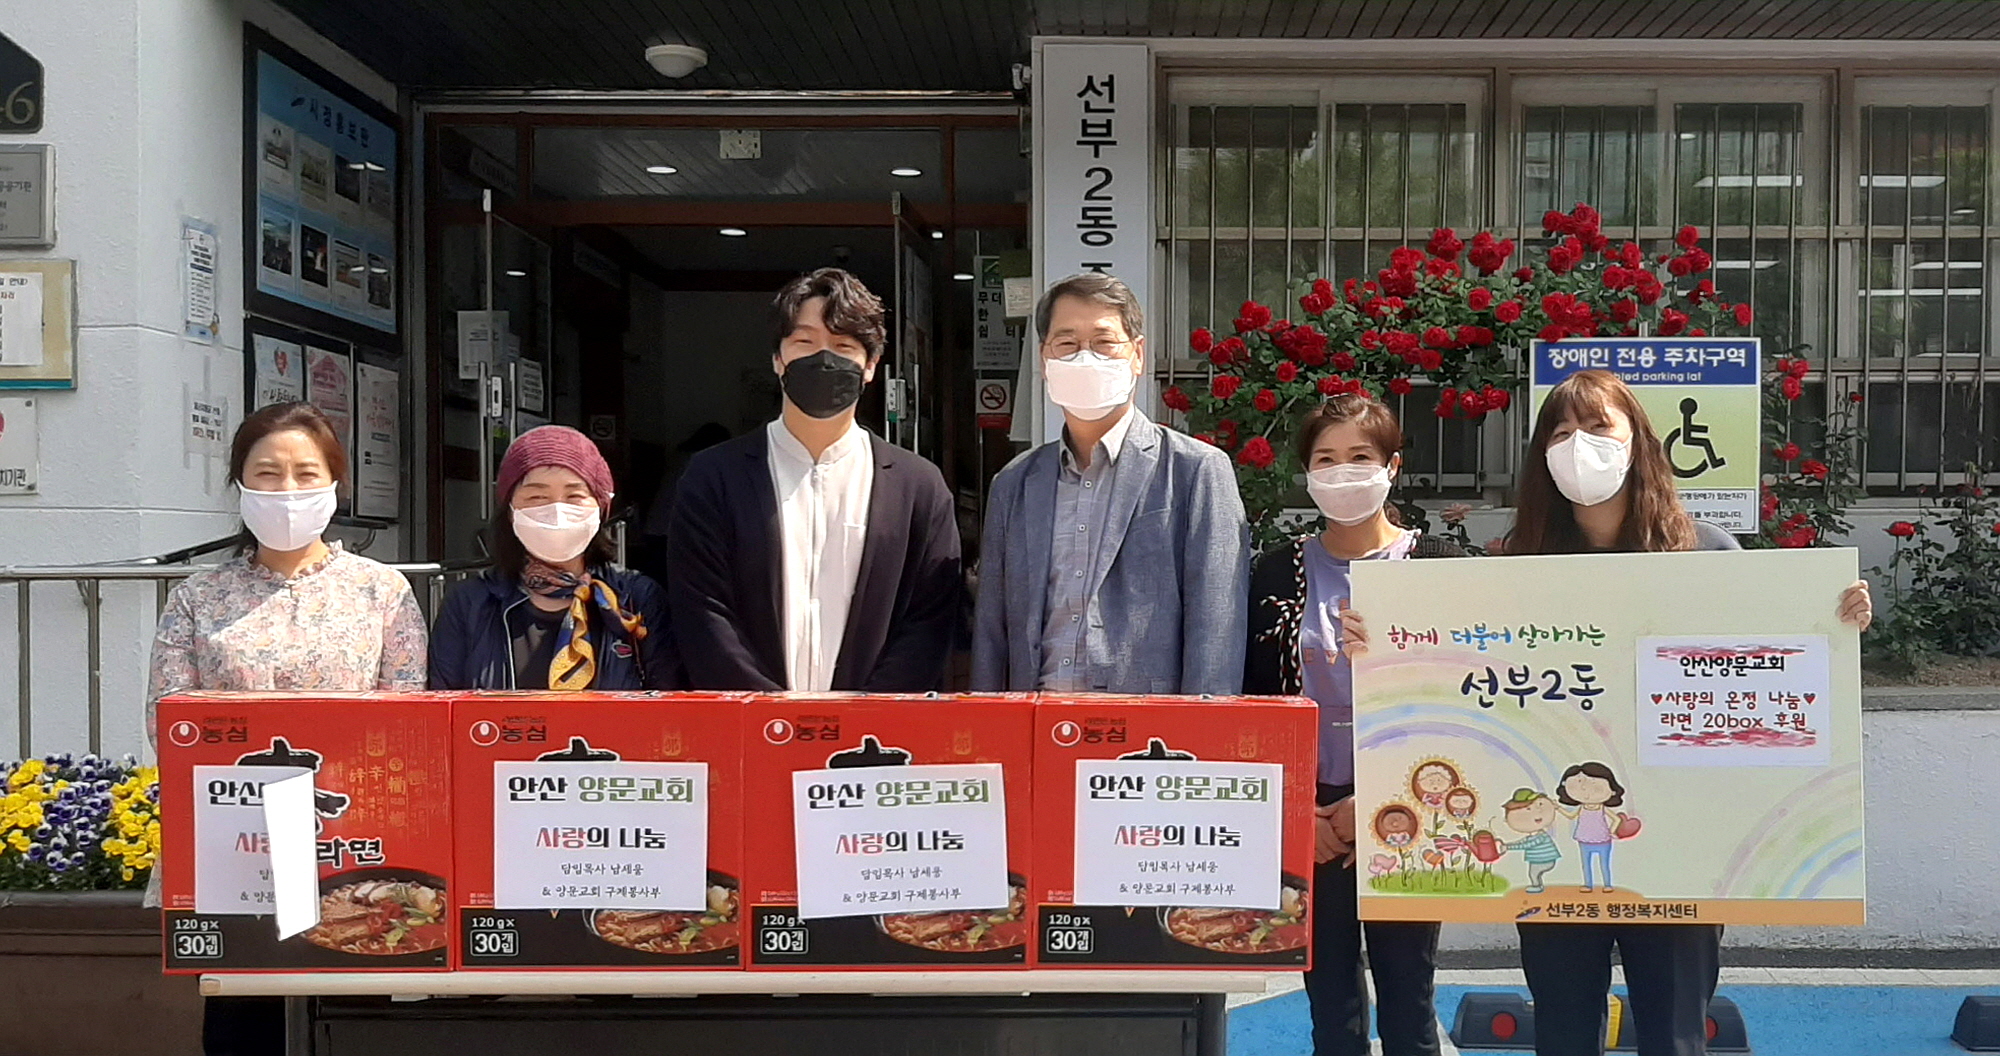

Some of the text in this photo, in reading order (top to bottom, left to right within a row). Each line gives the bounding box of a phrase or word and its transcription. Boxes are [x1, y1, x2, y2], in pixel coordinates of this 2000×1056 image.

[1076, 74, 1118, 247] 선부2동
[1547, 347, 1746, 369] 장애인 전용 주차구역
[1642, 372, 1684, 382] parking
[1387, 622, 1606, 651] 함께 더불어 살아가는
[1679, 655, 1785, 677] 안산양문교회
[1460, 663, 1605, 711] 선부2동
[1665, 691, 1801, 710] 사랑의 온정 나눔
[1660, 712, 1806, 731] 라면 20box 후원
[201, 725, 248, 744] 농심
[501, 724, 547, 743] 농심
[795, 723, 840, 742] 농심
[1082, 725, 1127, 743] 농심
[508, 776, 694, 803] 안산 양문교회
[808, 779, 989, 809] 안산 양문교회
[1089, 774, 1268, 802] 안산 양문교회
[536, 827, 667, 849] 사랑의 나눔
[836, 830, 965, 855] 사랑의 나눔
[1114, 824, 1241, 847] 사랑의 나눔
[317, 838, 384, 867] 라면
[561, 862, 606, 876] 담임목사
[861, 867, 905, 881] 담임목사
[1138, 861, 1181, 874] 담임목사
[240, 892, 249, 901] &
[542, 884, 661, 899] & 양문교회 구제봉사부
[843, 888, 962, 904] & 양문교회 구제봉사부
[1119, 882, 1236, 896] & 양문교회 구제봉사부
[762, 914, 786, 926] 120
[1048, 914, 1071, 925] 120
[1546, 903, 1698, 919] 선부2동 행정복지센터
[175, 918, 199, 930] 120
[471, 917, 495, 927] 120
